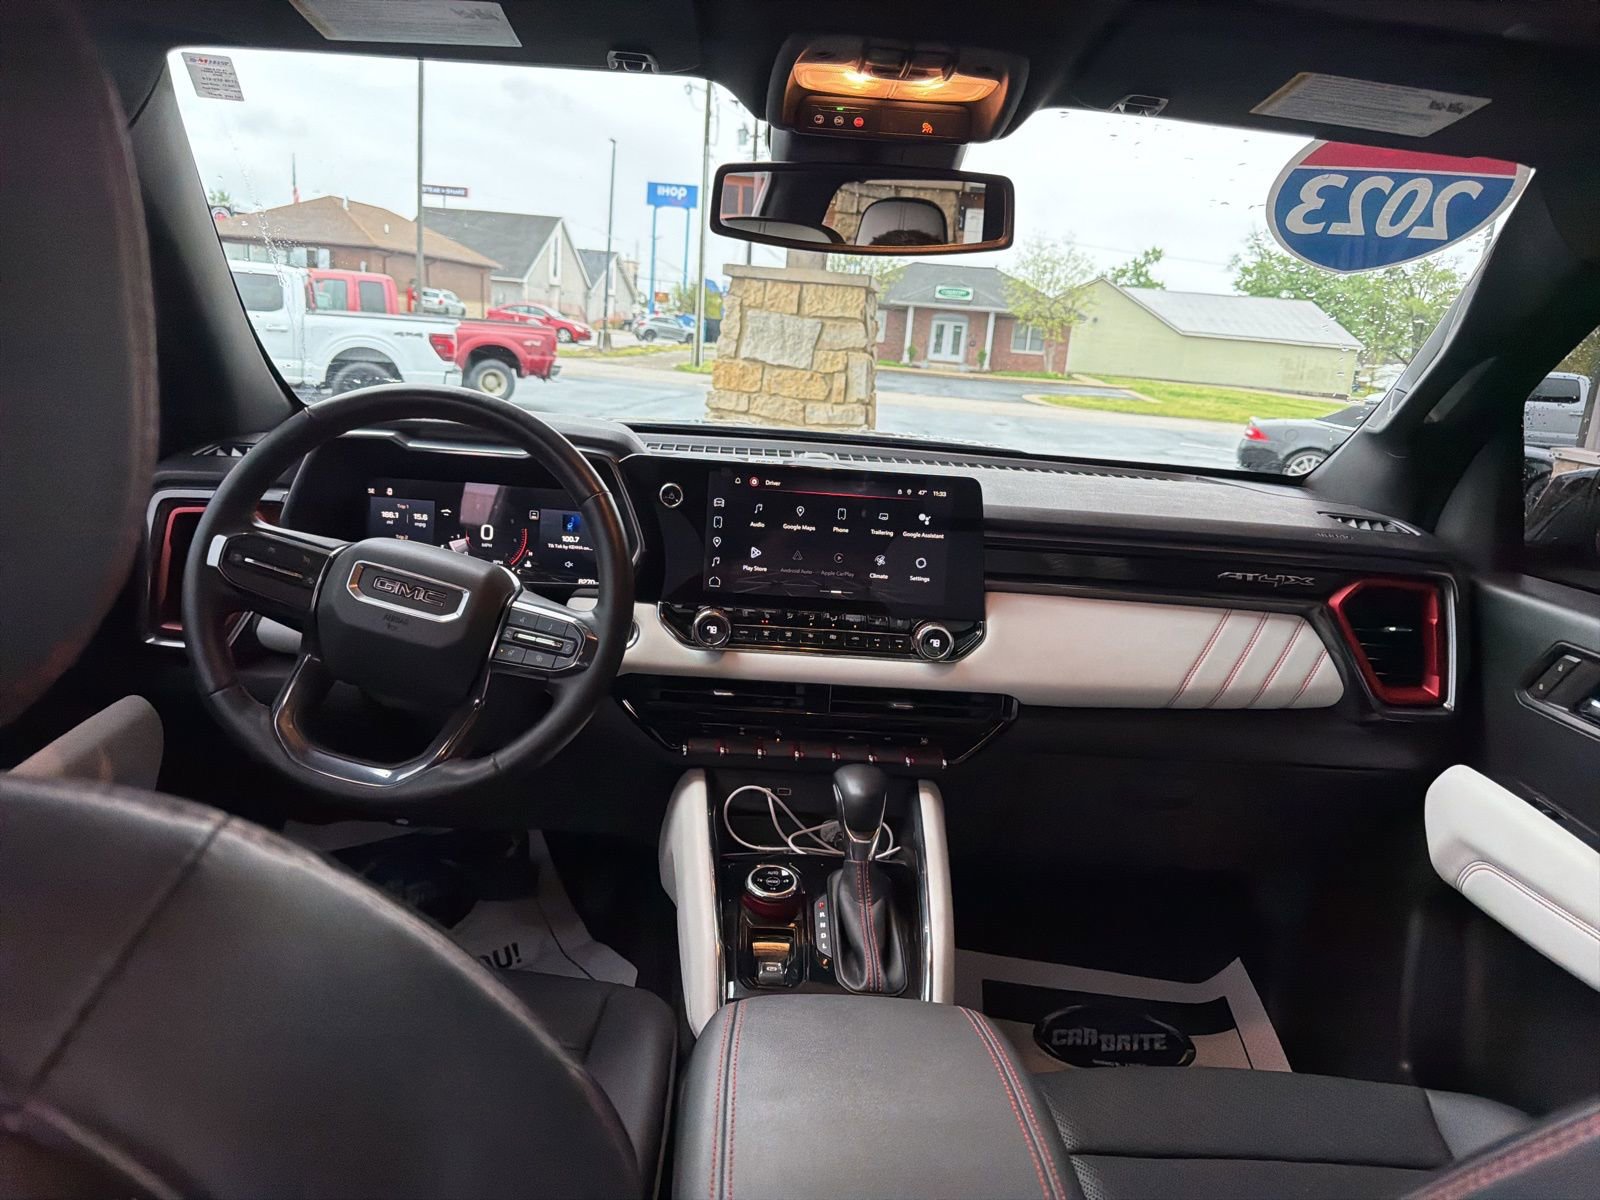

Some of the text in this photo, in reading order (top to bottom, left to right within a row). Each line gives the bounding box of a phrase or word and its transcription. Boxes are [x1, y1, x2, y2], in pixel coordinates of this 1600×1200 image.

[765, 479, 782, 487] Driver
[782, 523, 802, 532] Google
[480, 524, 494, 541] 0
[870, 528, 894, 538] Trailering
[902, 531, 945, 540] Google Assistant
[742, 564, 754, 573] Play
[780, 567, 801, 575] Android
[820, 569, 855, 578] Apple CarPlay
[869, 572, 889, 580] Climate
[909, 575, 931, 583] Settings
[1216, 571, 1315, 588] AT4X
[373, 577, 447, 608] GMC
[1050, 1026, 1169, 1052] CAR BRITE
